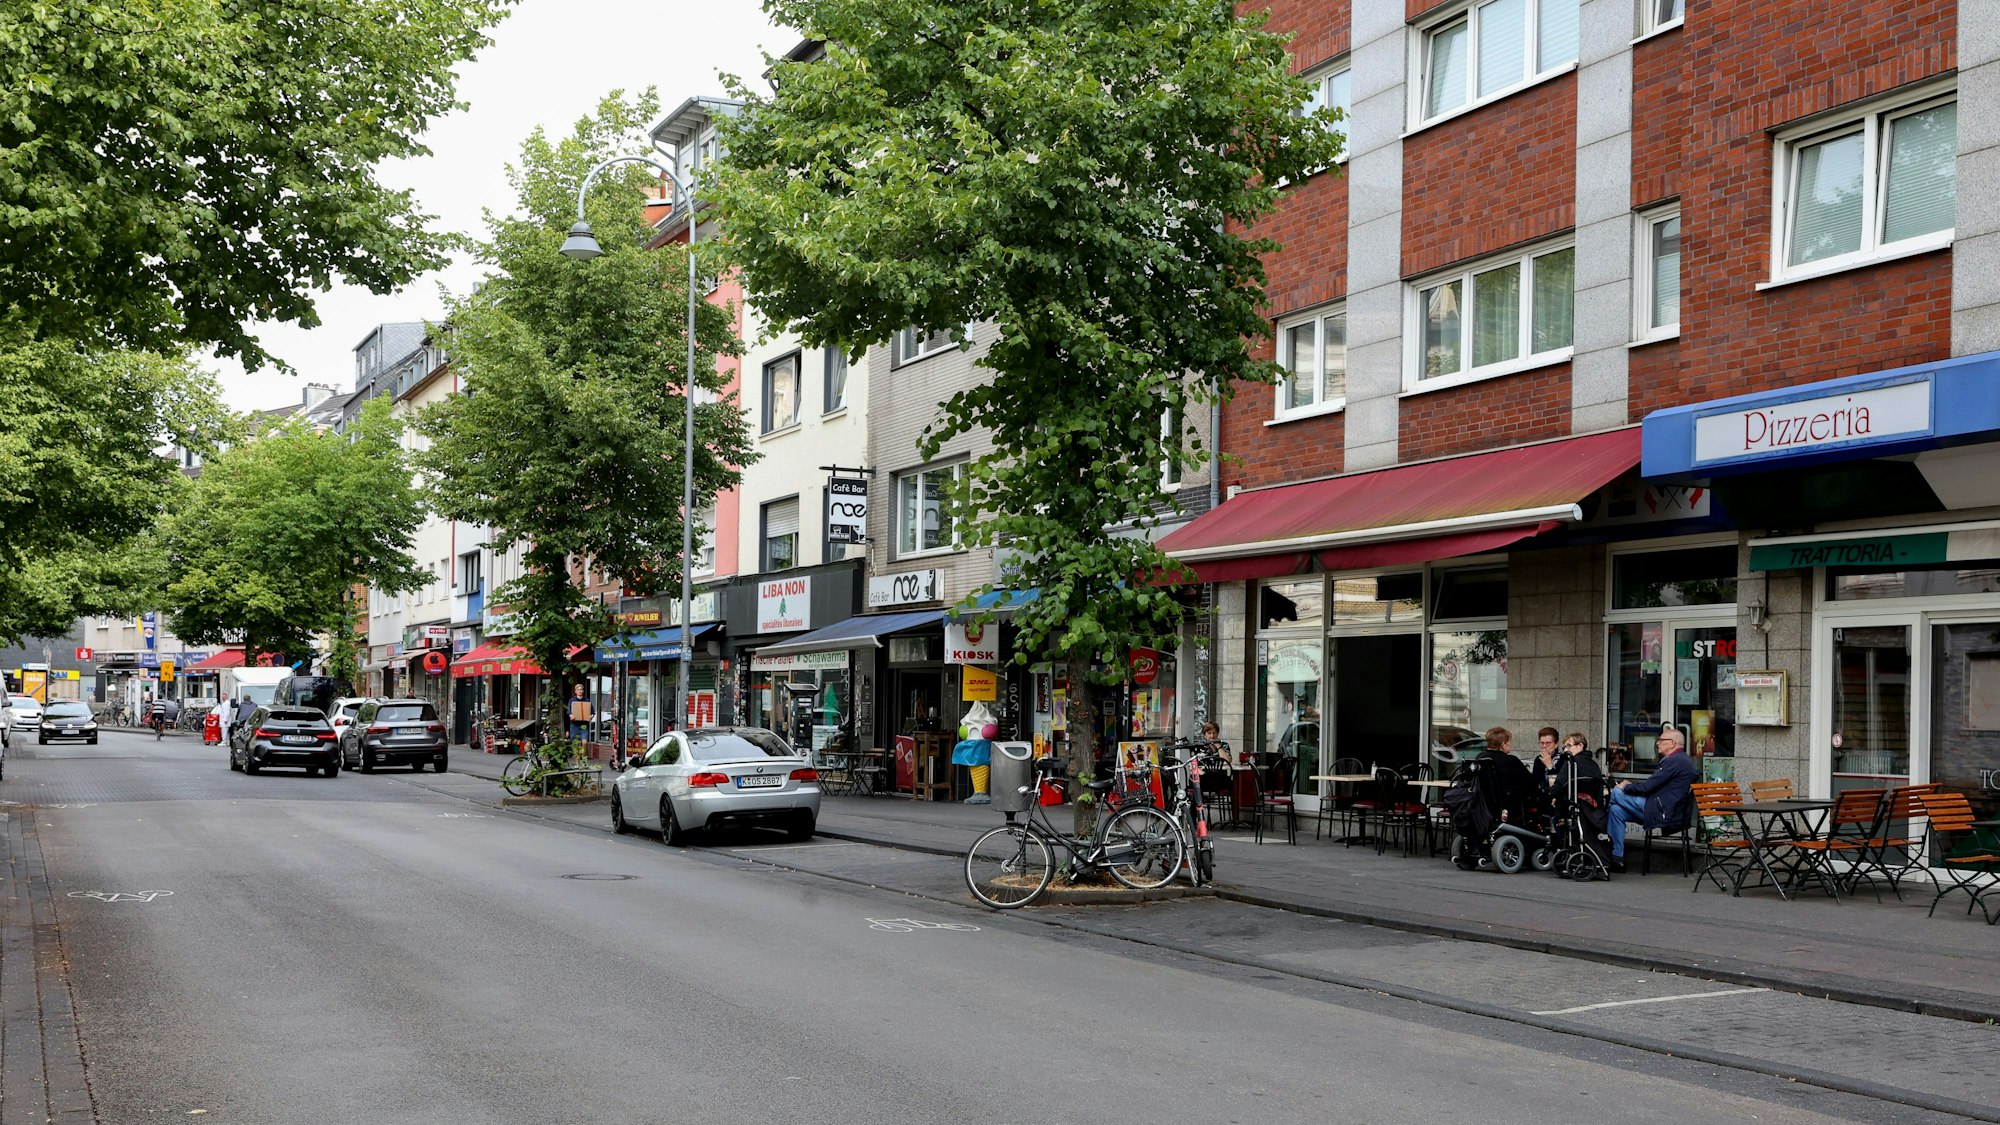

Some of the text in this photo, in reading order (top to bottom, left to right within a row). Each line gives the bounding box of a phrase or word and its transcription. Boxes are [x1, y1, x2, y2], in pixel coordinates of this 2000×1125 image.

[1743, 397, 1871, 450] Pizzeria
[852, 485, 865, 493] Bar
[1789, 543, 1894, 566] TRATTORIA
[881, 591, 890, 601] Bar
[634, 613, 659, 622] JUWELIER
[953, 650, 994, 660] KIOSK
[742, 778, 748, 786] K
[762, 776, 779, 785] 2887
